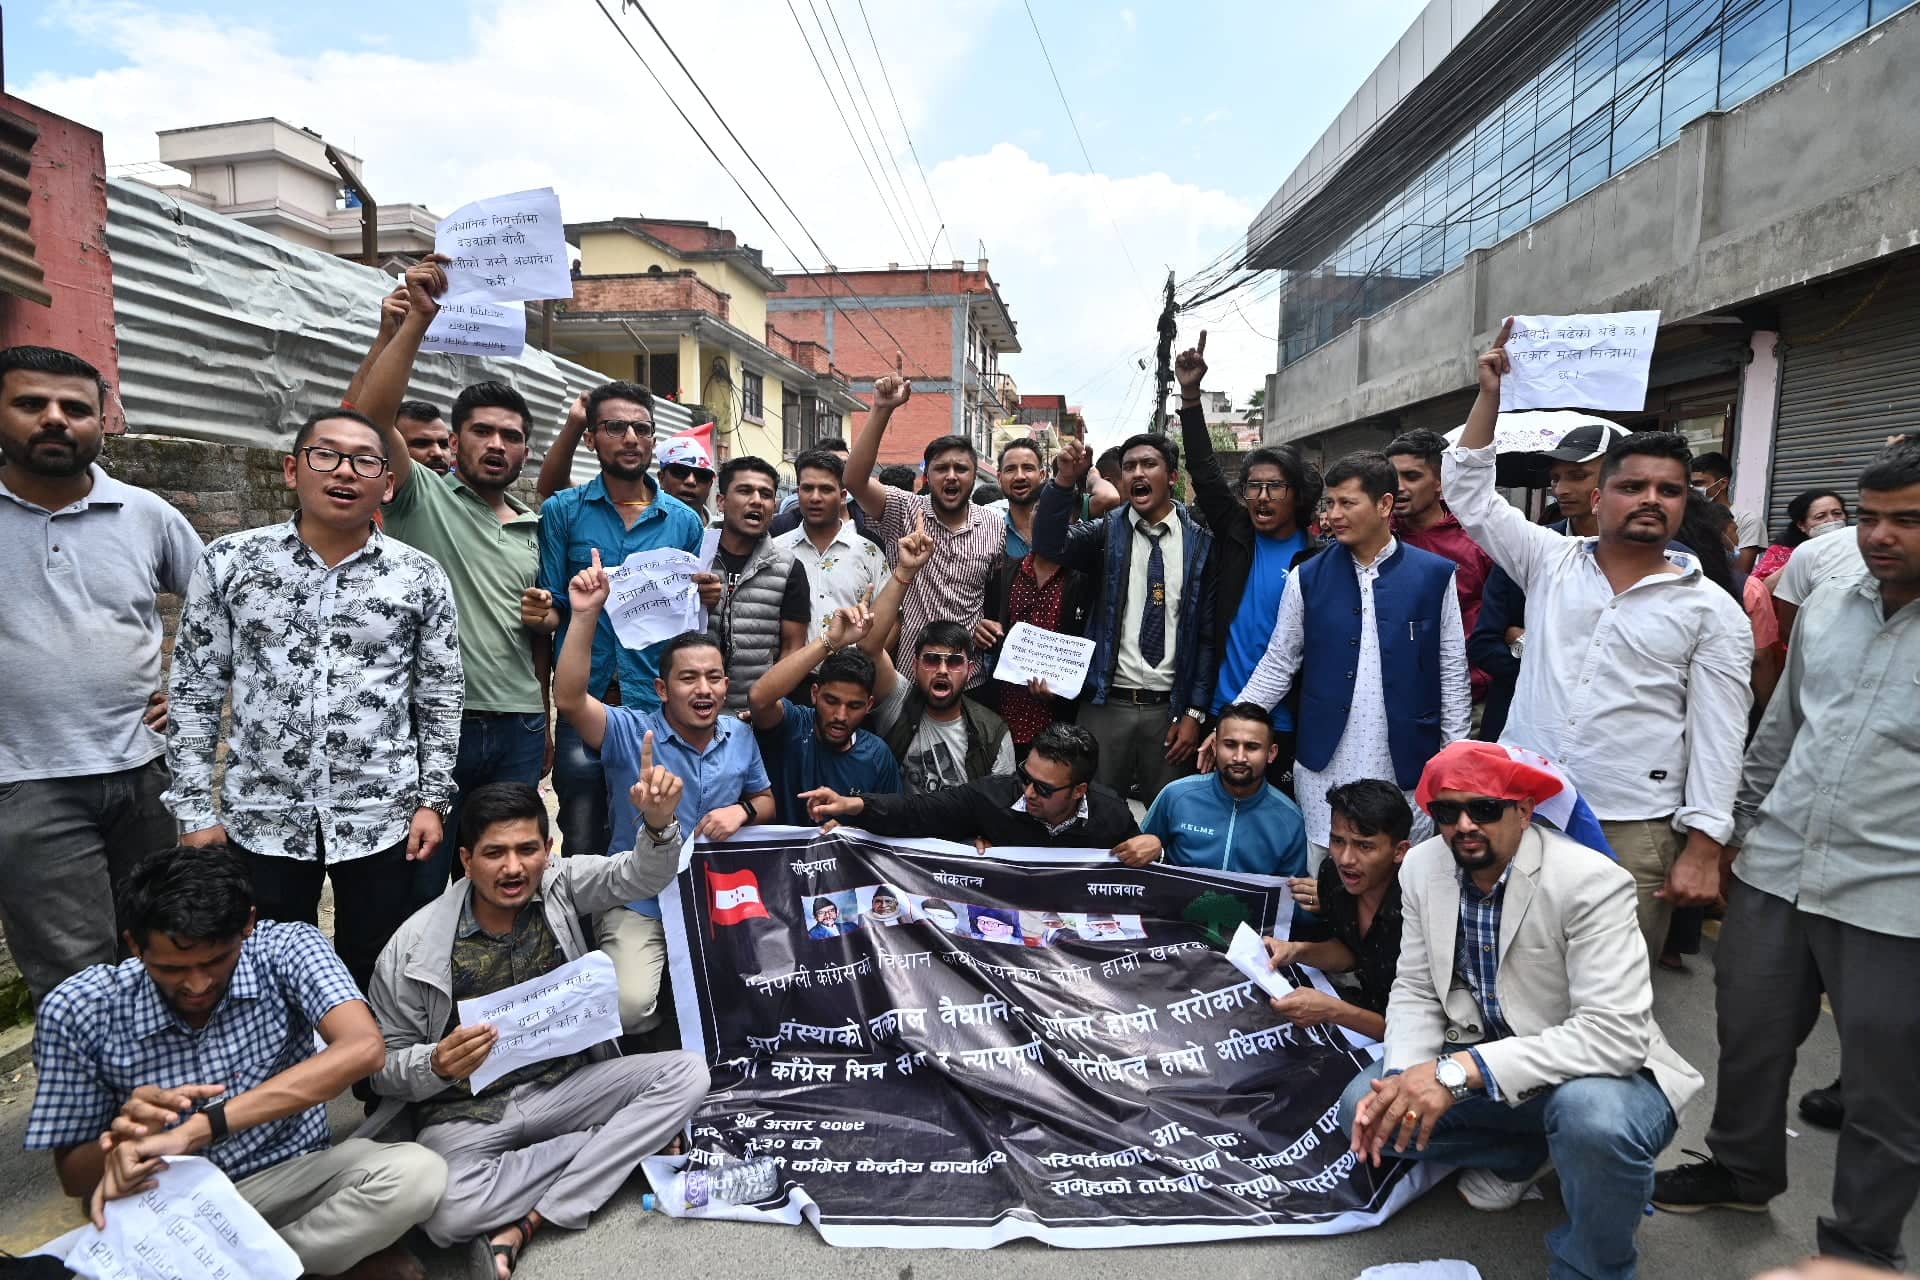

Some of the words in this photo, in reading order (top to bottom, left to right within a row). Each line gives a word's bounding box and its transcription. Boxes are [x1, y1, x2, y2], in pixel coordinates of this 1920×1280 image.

[1180, 821, 1217, 837] KELME
[933, 870, 985, 889] लोकतन्त्र
[1087, 882, 1147, 898] समाजवाद
[878, 947, 932, 970] विधान
[1102, 1003, 1159, 1037] हाम्रो
[1166, 979, 1259, 1024] सरोकार
[845, 1058, 888, 1082] भित्र
[1155, 1039, 1210, 1077] हाम्रो
[1214, 1022, 1299, 1063] अधिकार
[763, 1118, 816, 1132] असार
[791, 1136, 823, 1151] बजे
